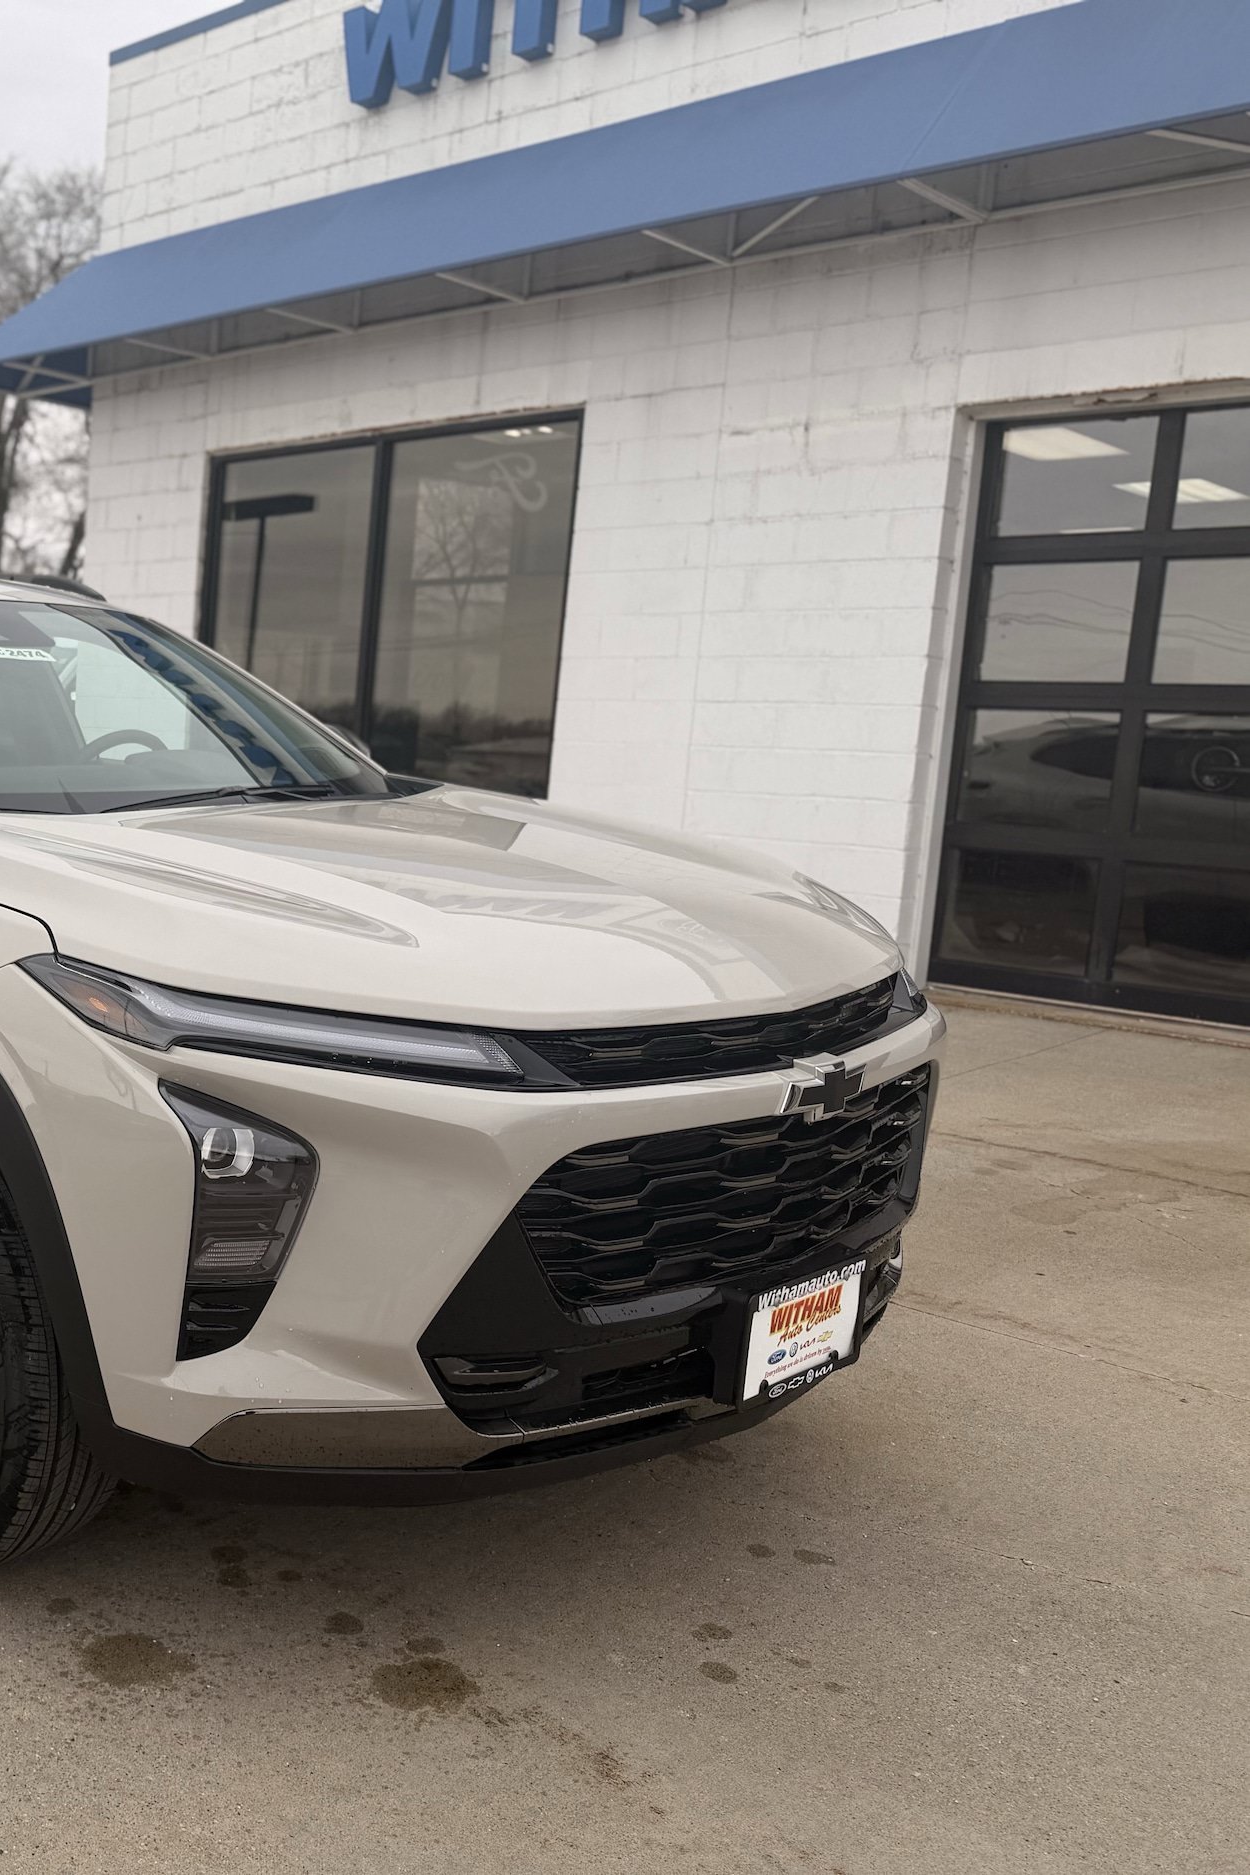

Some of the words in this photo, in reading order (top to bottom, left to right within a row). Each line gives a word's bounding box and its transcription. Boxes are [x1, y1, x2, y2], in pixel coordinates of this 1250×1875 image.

[758, 1259, 867, 1312] Withamauto.com
[769, 1282, 844, 1336] WITHAM
[777, 1324, 803, 1347] Auto
